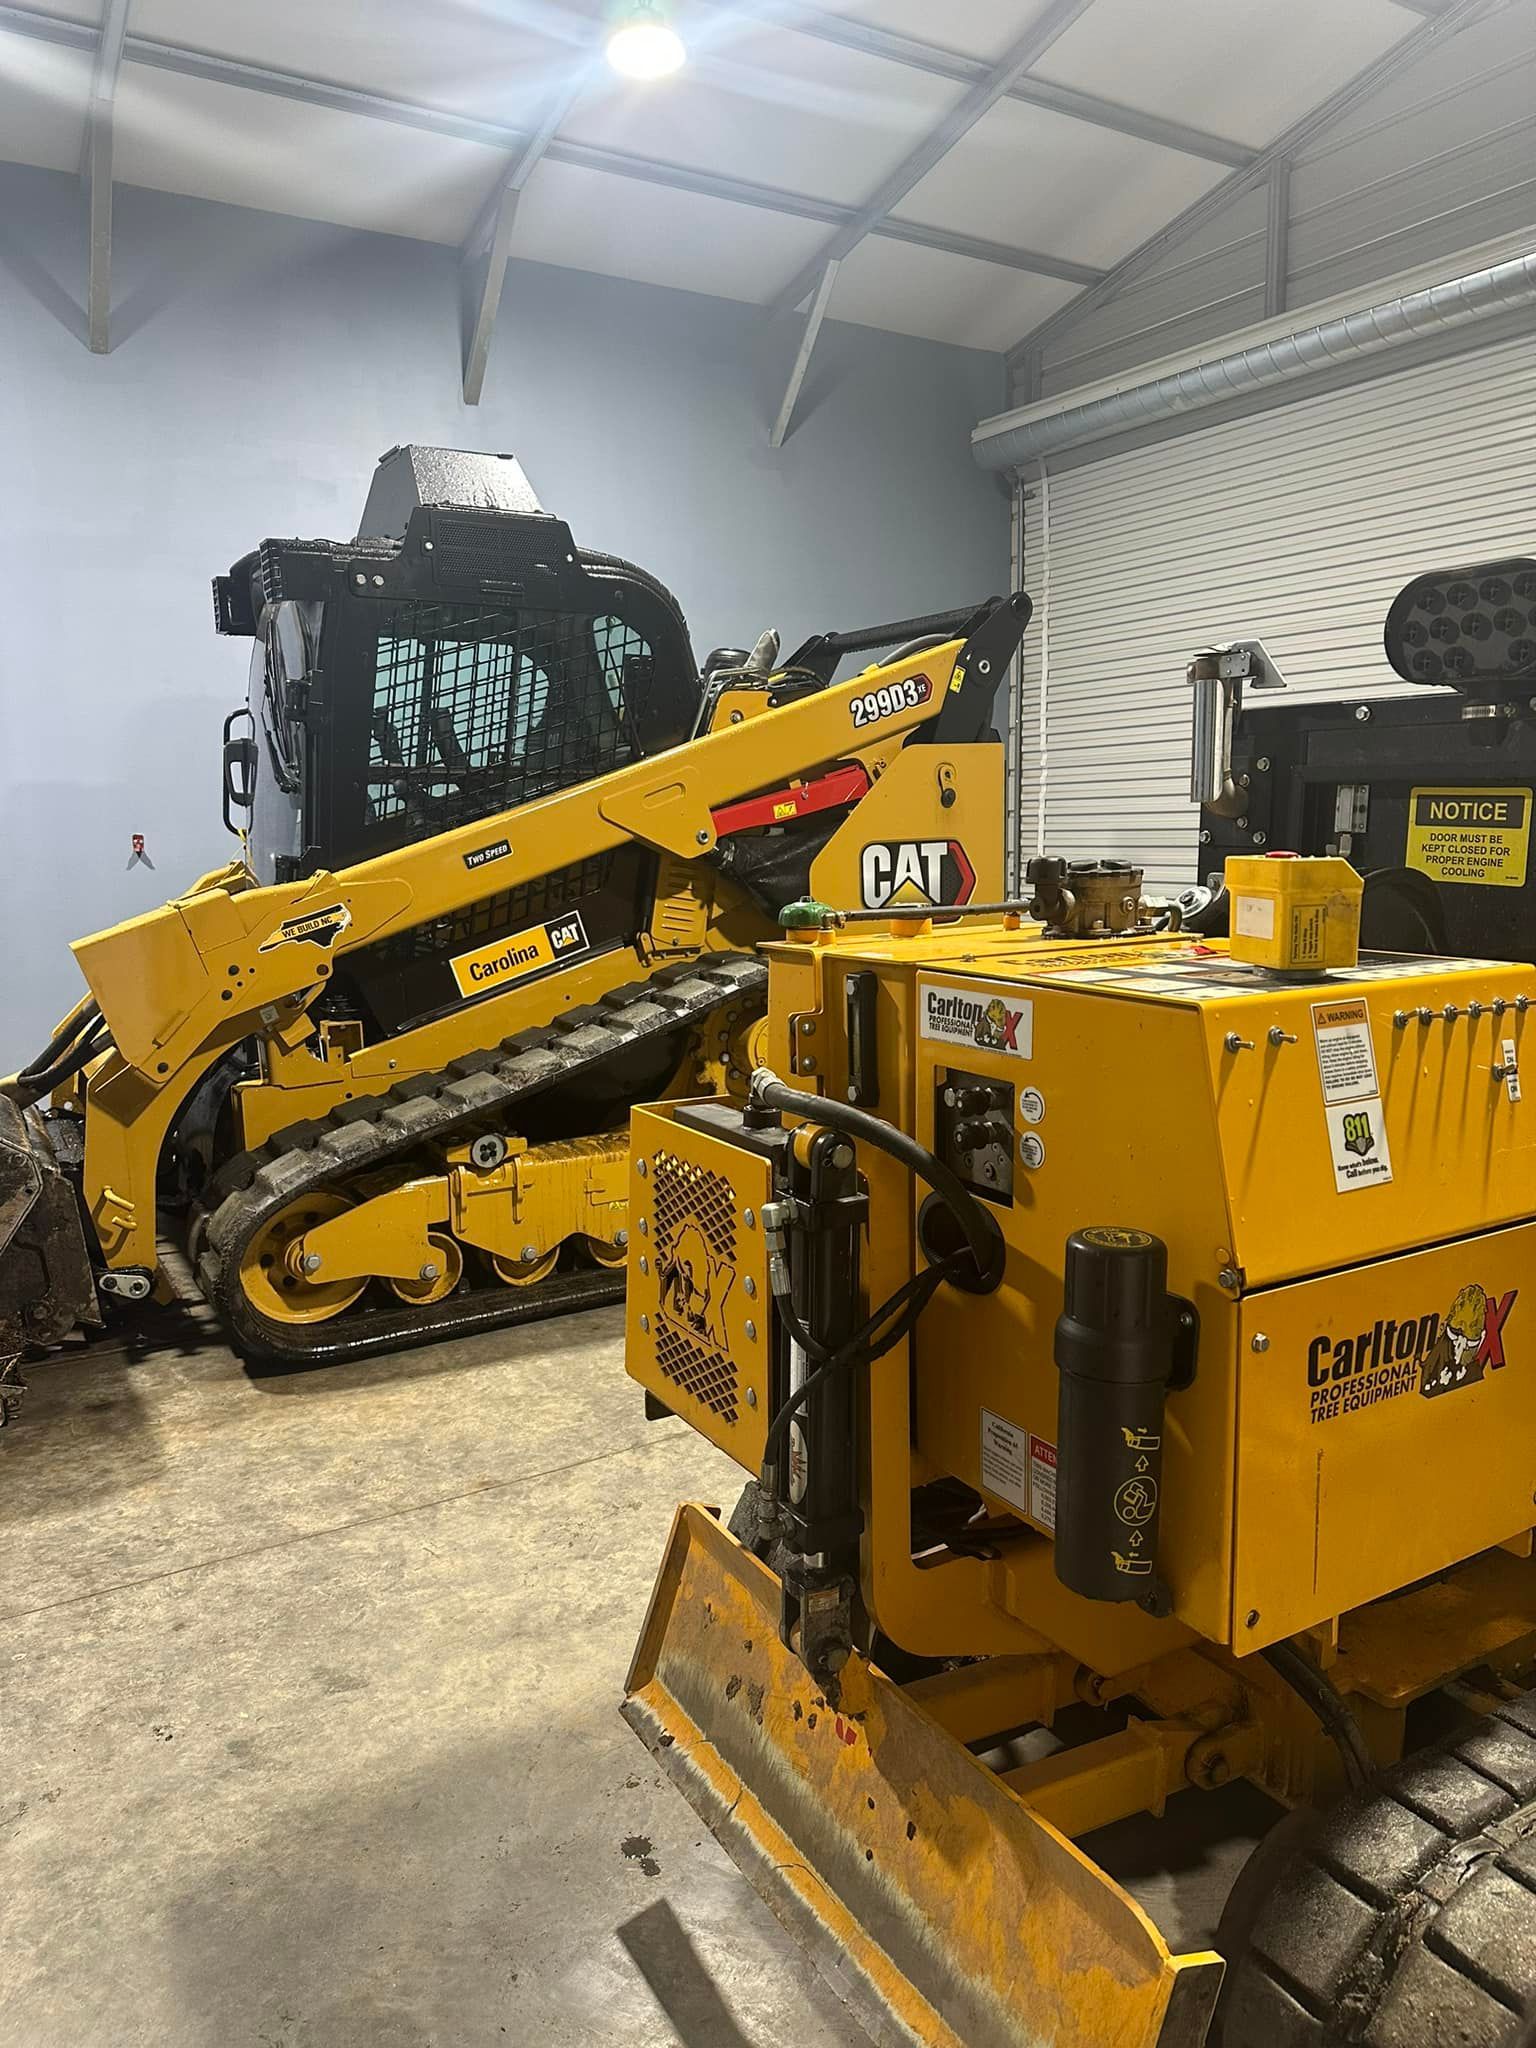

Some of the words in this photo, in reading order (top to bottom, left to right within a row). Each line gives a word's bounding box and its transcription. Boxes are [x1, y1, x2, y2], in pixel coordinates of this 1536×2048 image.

[850, 678, 919, 727] 299D3
[1430, 802, 1508, 821] NOTICE
[1430, 833, 1458, 842] DOOR
[1460, 834, 1487, 843] MUST
[1489, 835, 1503, 844] BE
[1422, 844, 1446, 853] KEPT
[1448, 845, 1487, 855] CLOSED
[1490, 847, 1511, 856] FOR
[1426, 855, 1464, 865] PROPER
[1466, 857, 1503, 867] ENGINE
[862, 841, 948, 909] CAT
[1441, 867, 1485, 877] COOLING
[282, 928, 296, 938] WE
[297, 920, 320, 933] BUILD
[320, 916, 333, 925] NC
[550, 922, 579, 949] CAT
[469, 943, 540, 982] Carolina
[927, 991, 983, 1024] Carlton
[1327, 1009, 1364, 1022] WARNING
[928, 1015, 975, 1030] PROFESSIONAL
[929, 1022, 940, 1031] TREE
[941, 1025, 973, 1037] EQUIPMENT
[1343, 1112, 1371, 1142] 811
[1346, 1169, 1358, 1179] Call
[1307, 1312, 1441, 1388] Carlton
[1310, 1361, 1418, 1409] PROFESSIONAL
[1311, 1401, 1339, 1424] TREE
[1343, 1375, 1417, 1414] EQUIPMENT
